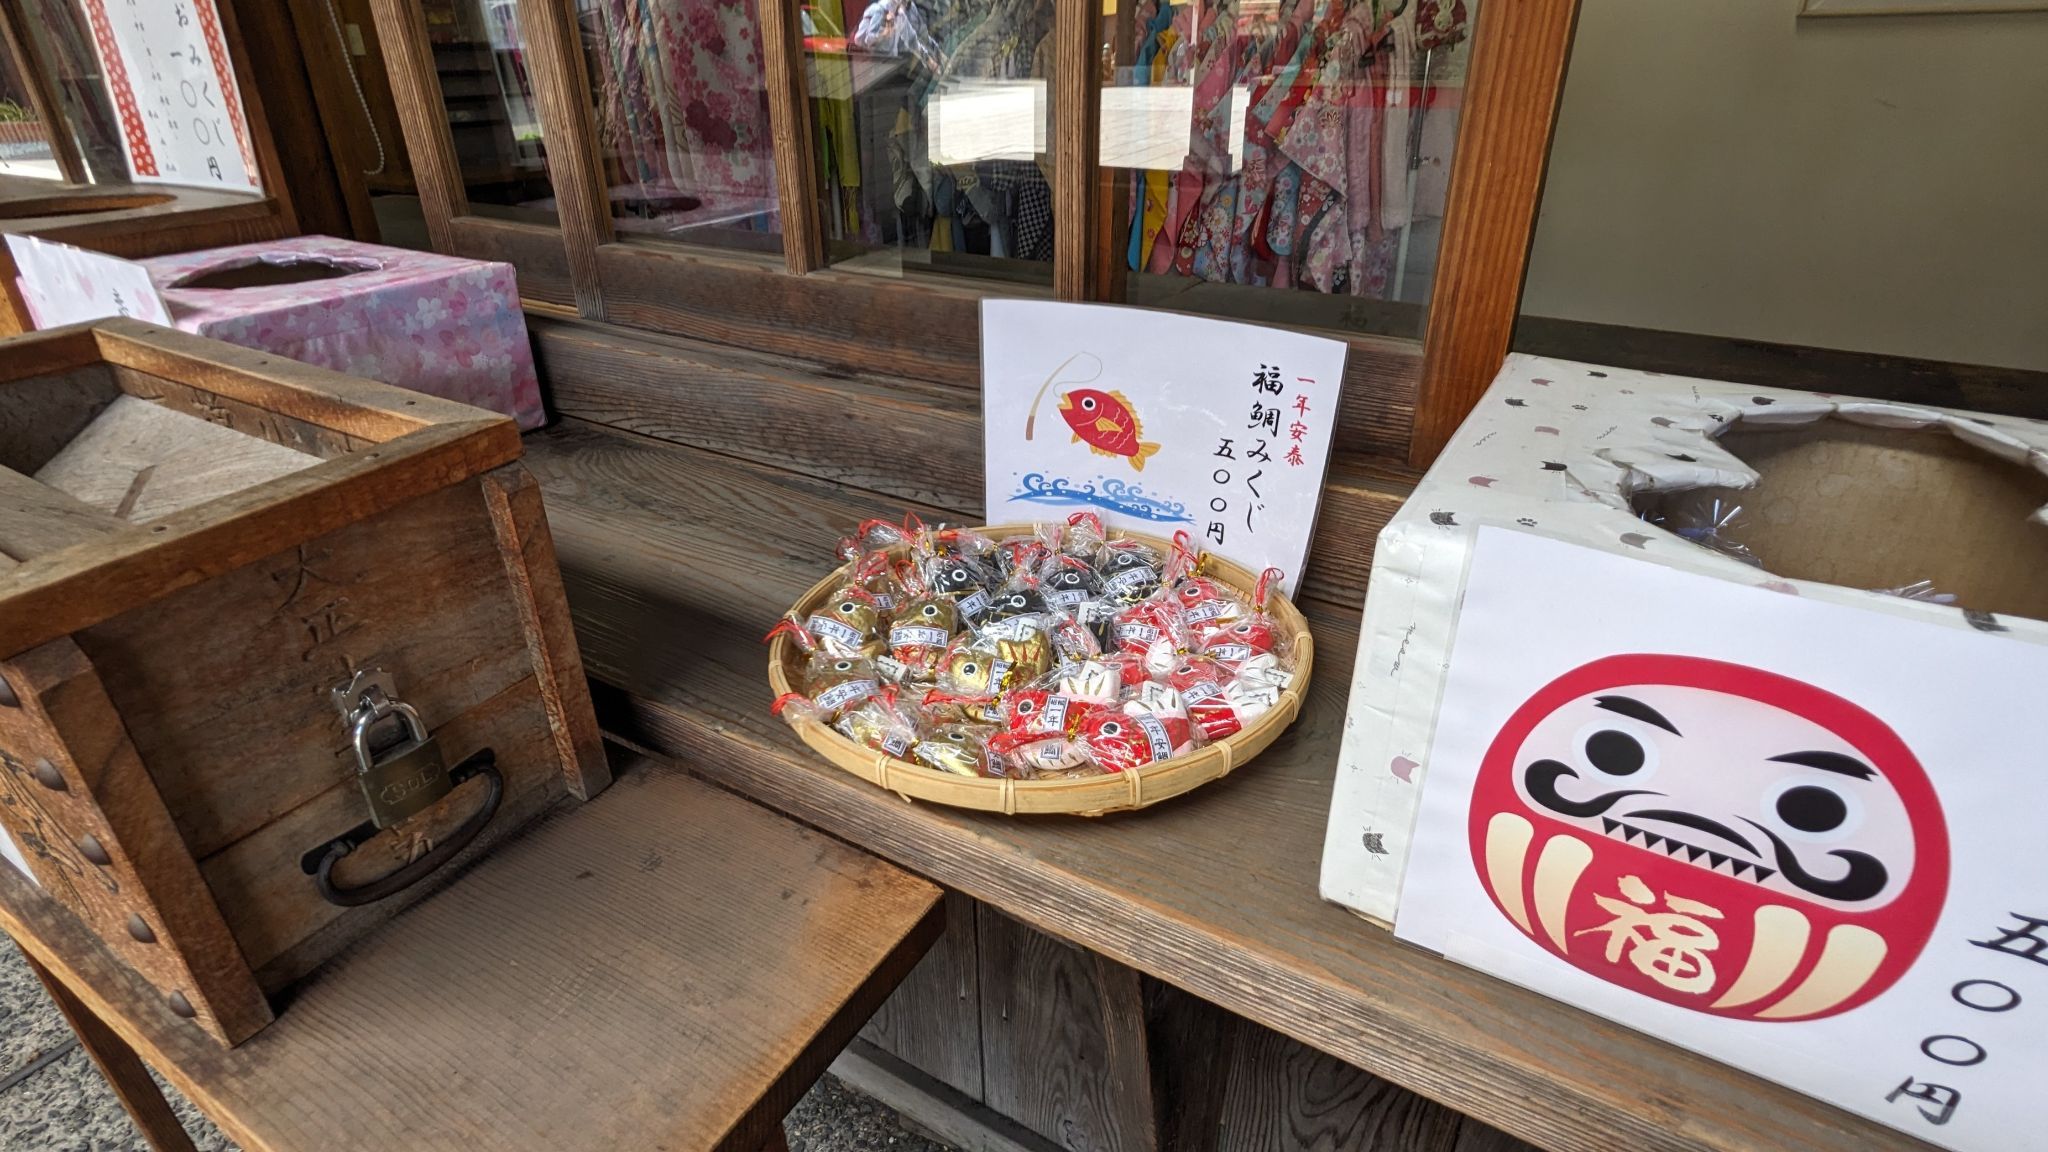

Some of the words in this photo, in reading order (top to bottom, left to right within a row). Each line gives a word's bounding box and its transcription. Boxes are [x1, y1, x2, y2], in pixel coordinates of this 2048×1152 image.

[1245, 363, 1284, 533] 福鯛みくじ
[1282, 376, 1316, 467] 一年安泰
[1573, 874, 1725, 995] 福
